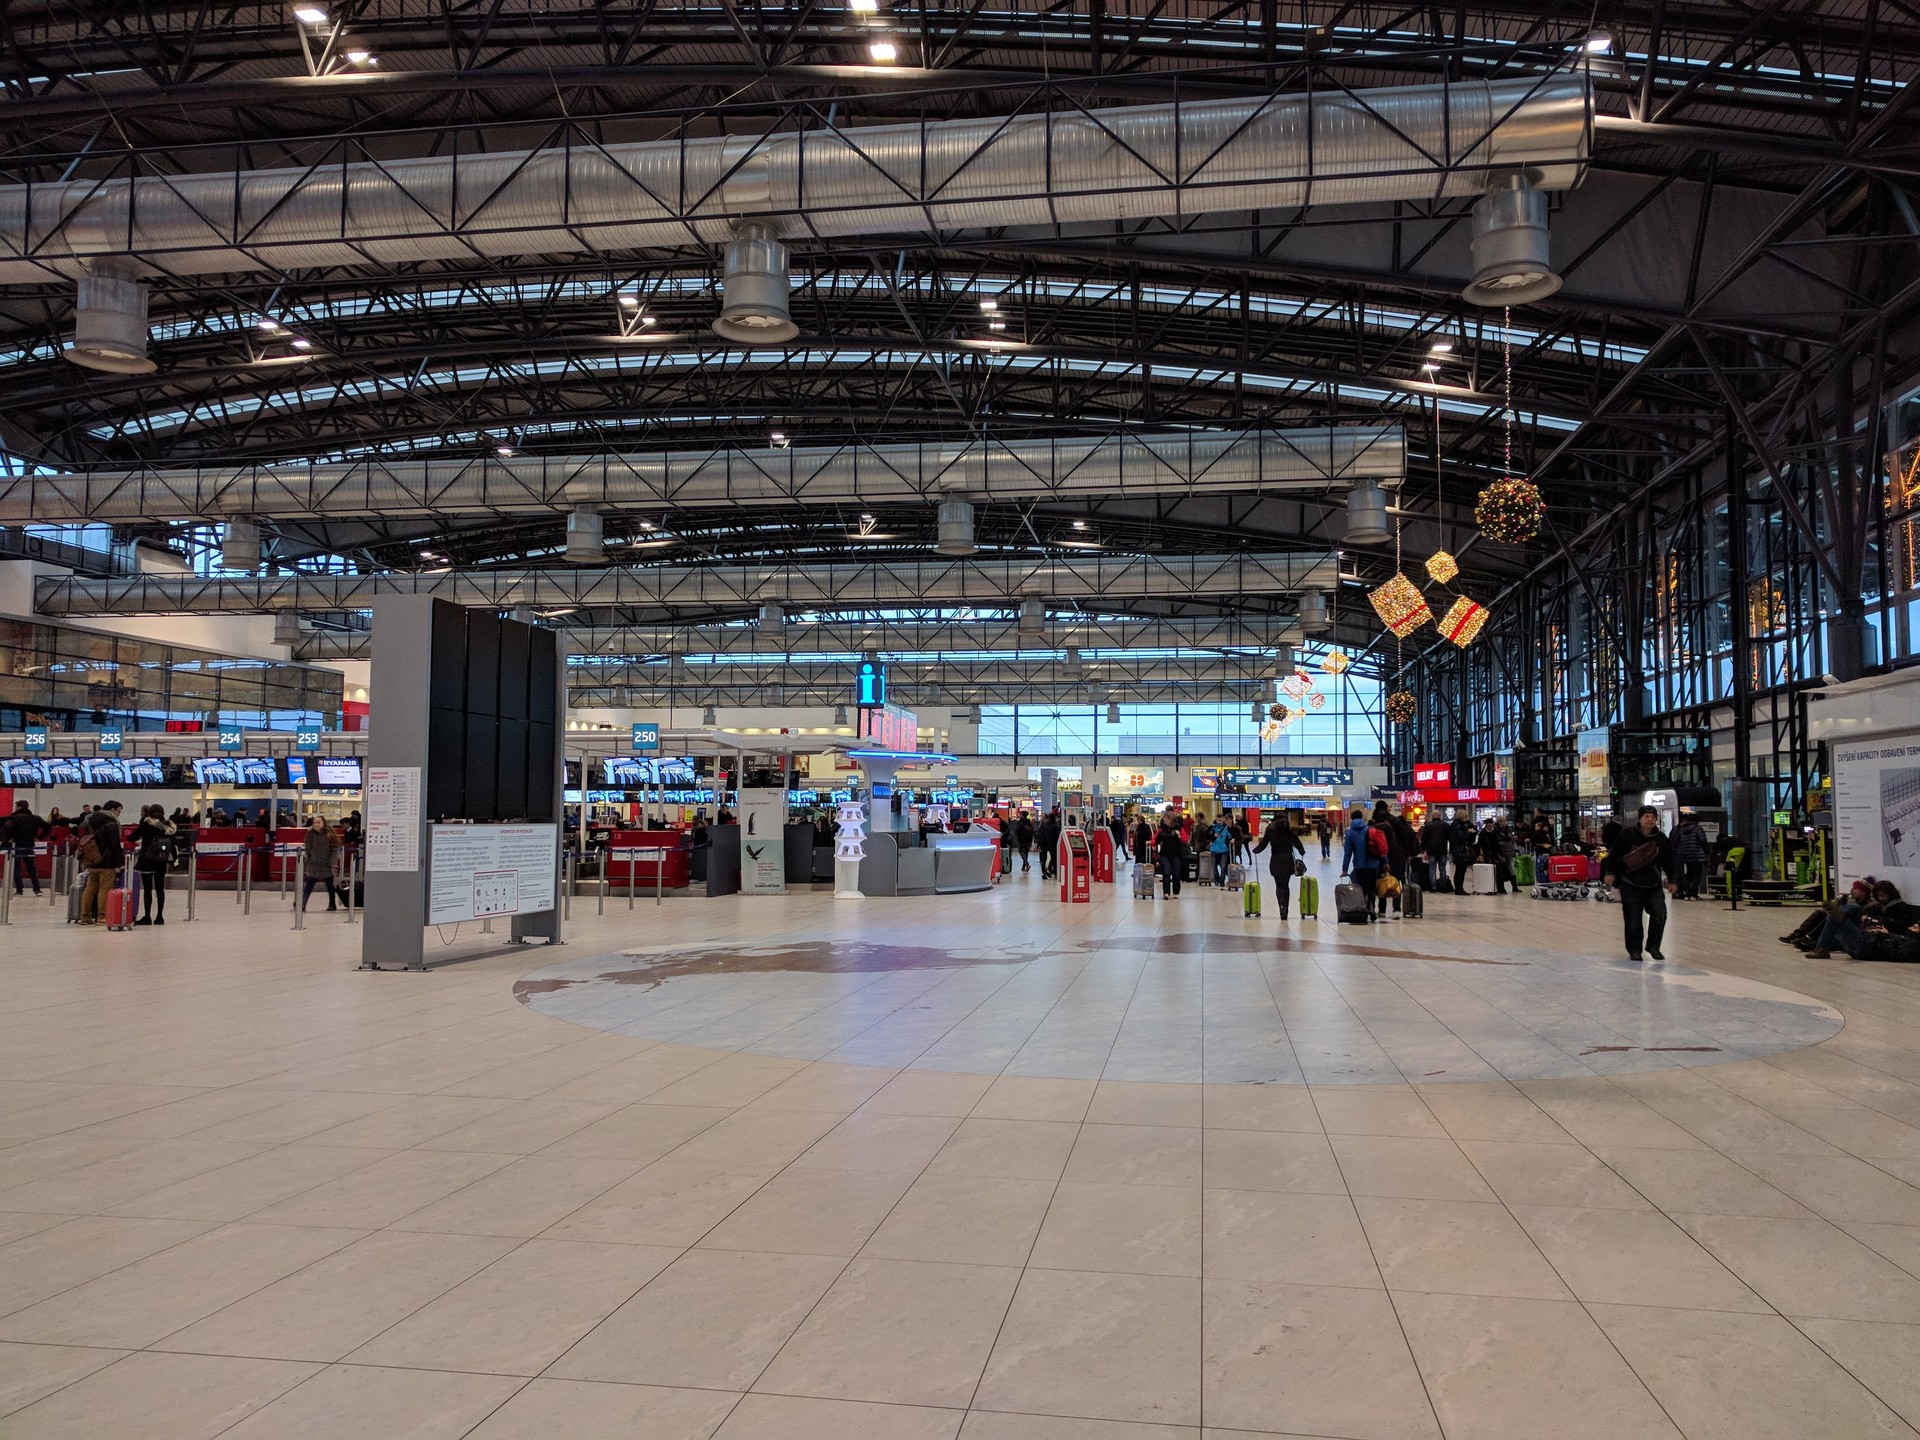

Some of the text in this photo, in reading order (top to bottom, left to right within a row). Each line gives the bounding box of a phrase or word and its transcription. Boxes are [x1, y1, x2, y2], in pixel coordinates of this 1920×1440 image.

[26, 733, 45, 744] 256
[101, 733, 121, 744] 255
[220, 733, 241, 744] 254
[298, 733, 318, 744] 253
[634, 731, 656, 743] 250
[1837, 750, 1856, 762] ZVÝŠENÍ
[1857, 750, 1880, 760] KAPACITY
[1880, 745, 1905, 759] ODBAVENÍ
[1417, 770, 1434, 781] RELAY
[1437, 770, 1449, 781] RELAY
[1458, 789, 1480, 800] RELAY
